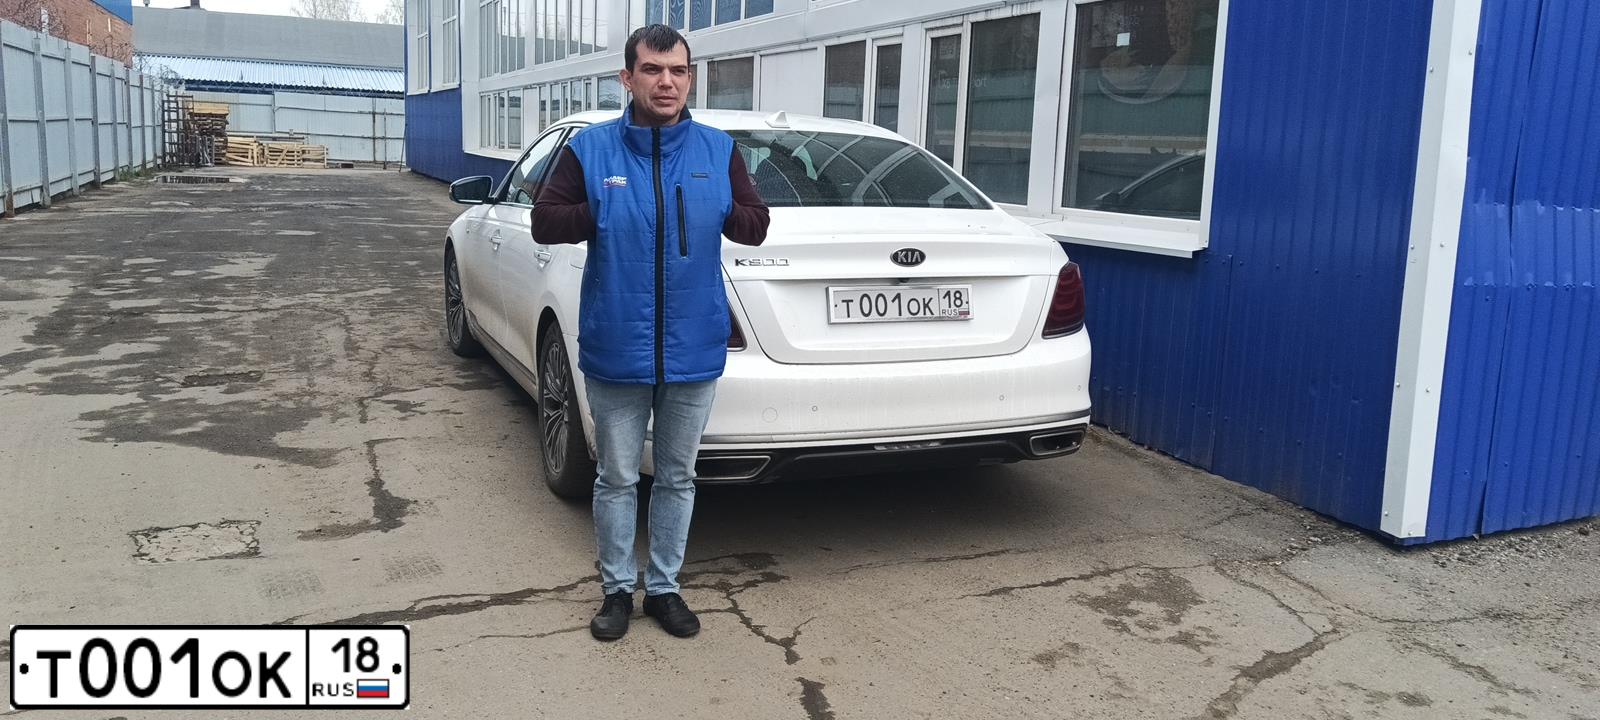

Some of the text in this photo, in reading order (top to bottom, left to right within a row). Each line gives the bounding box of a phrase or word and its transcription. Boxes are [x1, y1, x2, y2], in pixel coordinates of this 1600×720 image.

[897, 251, 922, 263] KIA
[942, 290, 964, 309] 18
[941, 308, 958, 316] RUS
